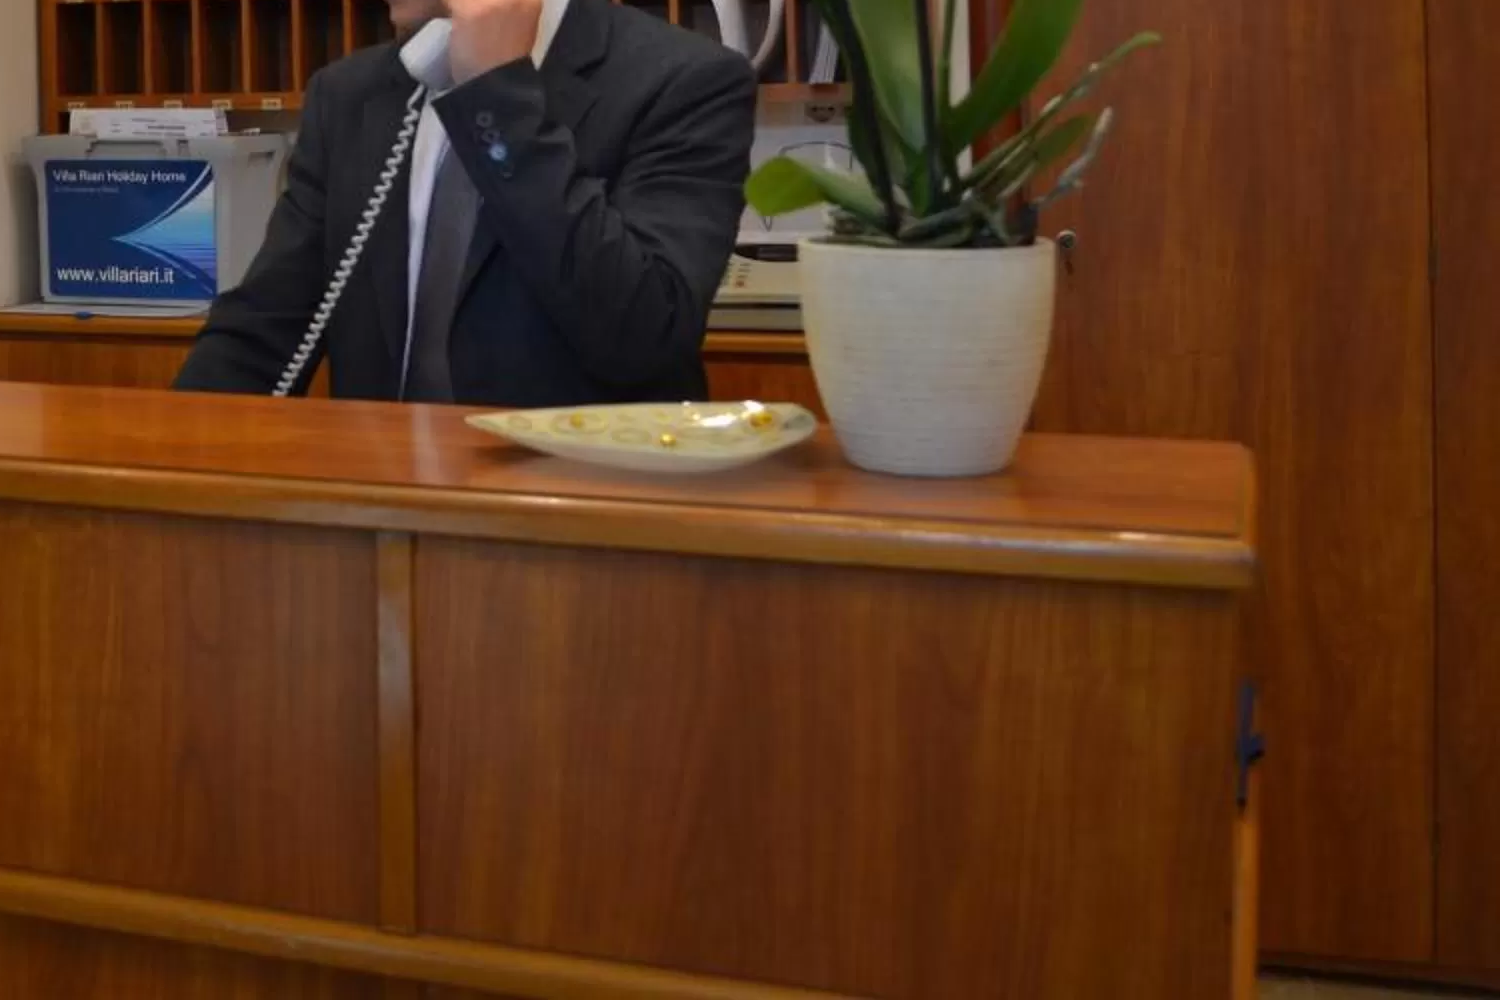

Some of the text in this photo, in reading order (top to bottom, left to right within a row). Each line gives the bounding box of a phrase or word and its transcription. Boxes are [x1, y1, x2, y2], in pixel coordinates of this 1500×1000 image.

[53, 168, 76, 182] Villa
[106, 168, 149, 184] Holiday
[151, 169, 187, 182] Home
[56, 265, 175, 284] www.villariari.it
